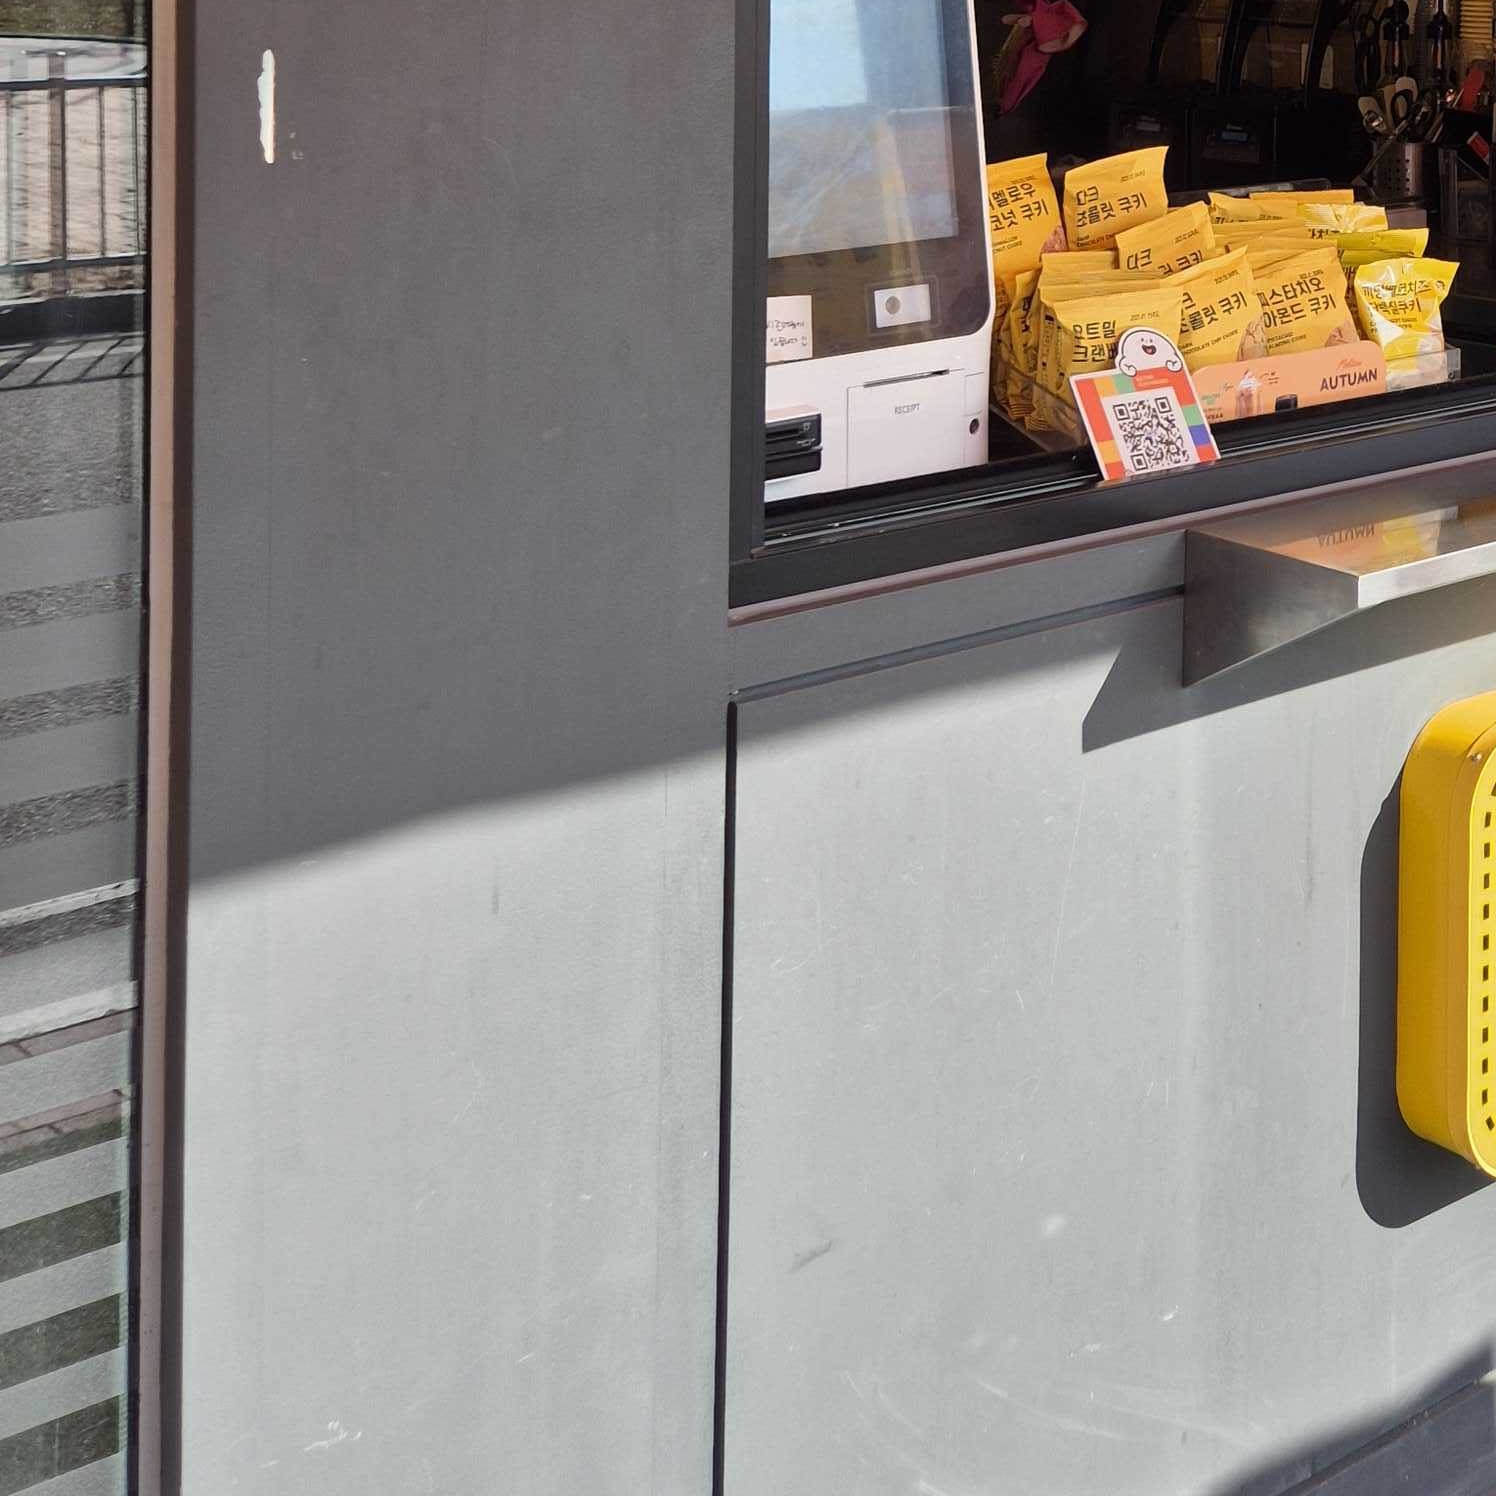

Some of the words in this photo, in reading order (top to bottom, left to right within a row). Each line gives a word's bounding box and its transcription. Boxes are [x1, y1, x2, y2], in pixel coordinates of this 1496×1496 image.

[989, 183, 1036, 210] 멜로우
[1076, 186, 1099, 206] 다크
[1118, 192, 1148, 213] 쿠키
[1020, 198, 1049, 221] 쿠키
[1126, 248, 1153, 271] 다크
[1218, 291, 1248, 315] 쿠키
[1256, 278, 1325, 307] 피스타치오
[1262, 303, 1306, 328] 아몬드
[1308, 294, 1336, 315] 쿠키
[1072, 320, 1116, 340] 오트밀
[1319, 368, 1378, 392] AUTUMN
